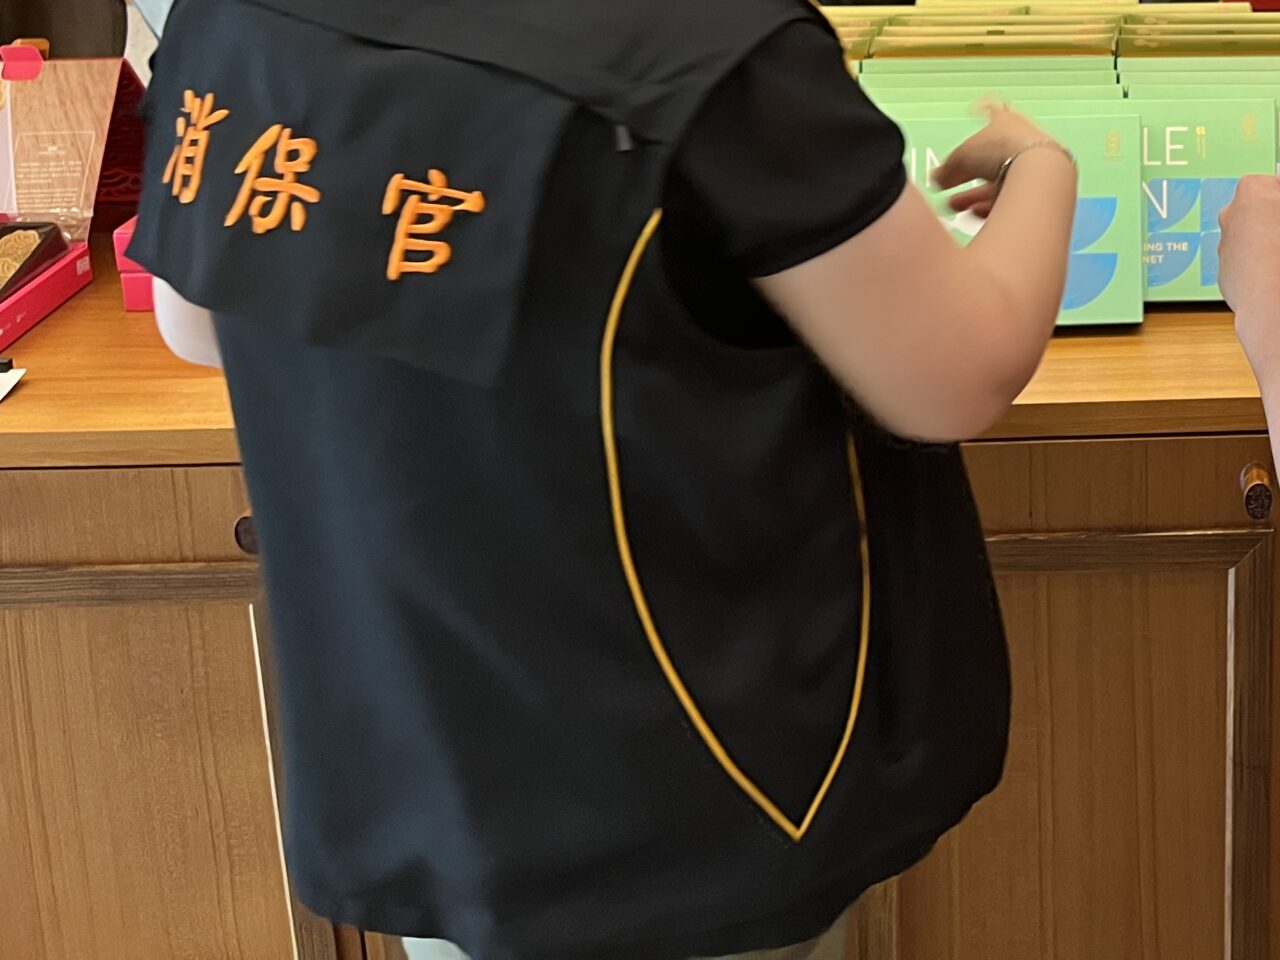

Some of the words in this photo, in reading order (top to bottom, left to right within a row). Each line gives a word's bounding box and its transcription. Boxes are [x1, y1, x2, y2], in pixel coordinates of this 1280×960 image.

[162, 90, 485, 280] 消保官
[1167, 242, 1189, 251] THE
